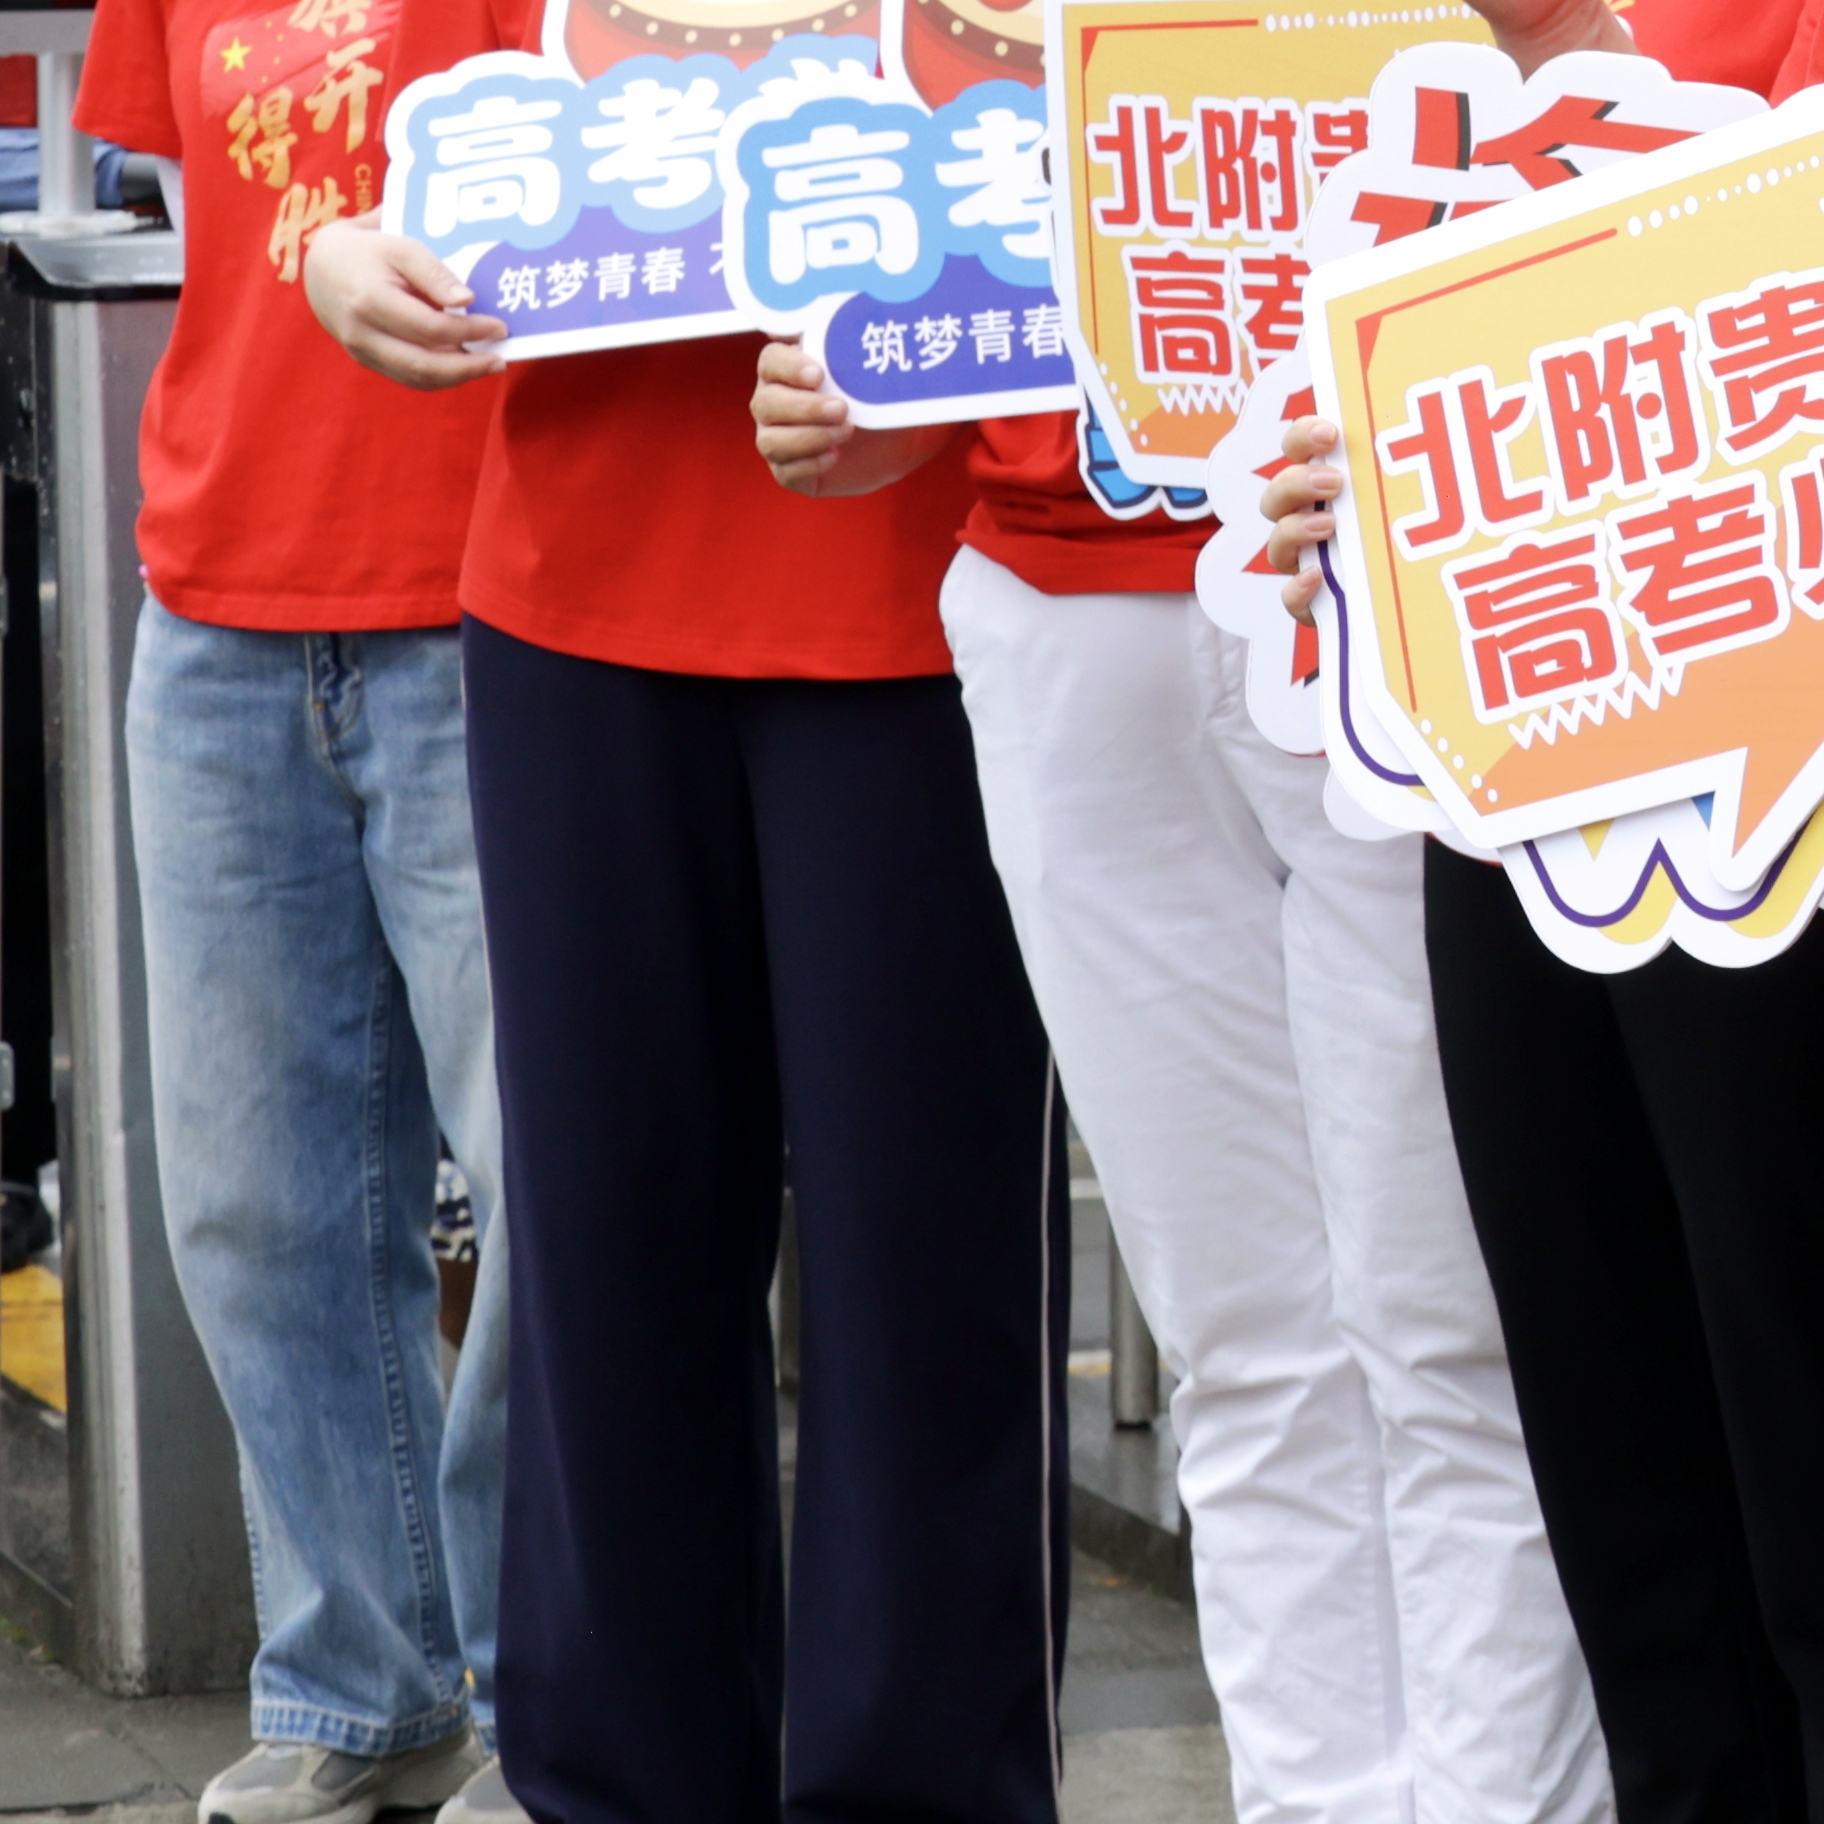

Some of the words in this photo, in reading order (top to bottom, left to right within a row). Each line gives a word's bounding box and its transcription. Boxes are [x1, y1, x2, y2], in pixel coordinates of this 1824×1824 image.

[428, 58, 870, 239] 高考
[762, 107, 1053, 285] 高考
[496, 245, 686, 314] 筑梦青春
[860, 303, 1066, 375] 筑梦青春
[1129, 250, 1312, 377] 高考
